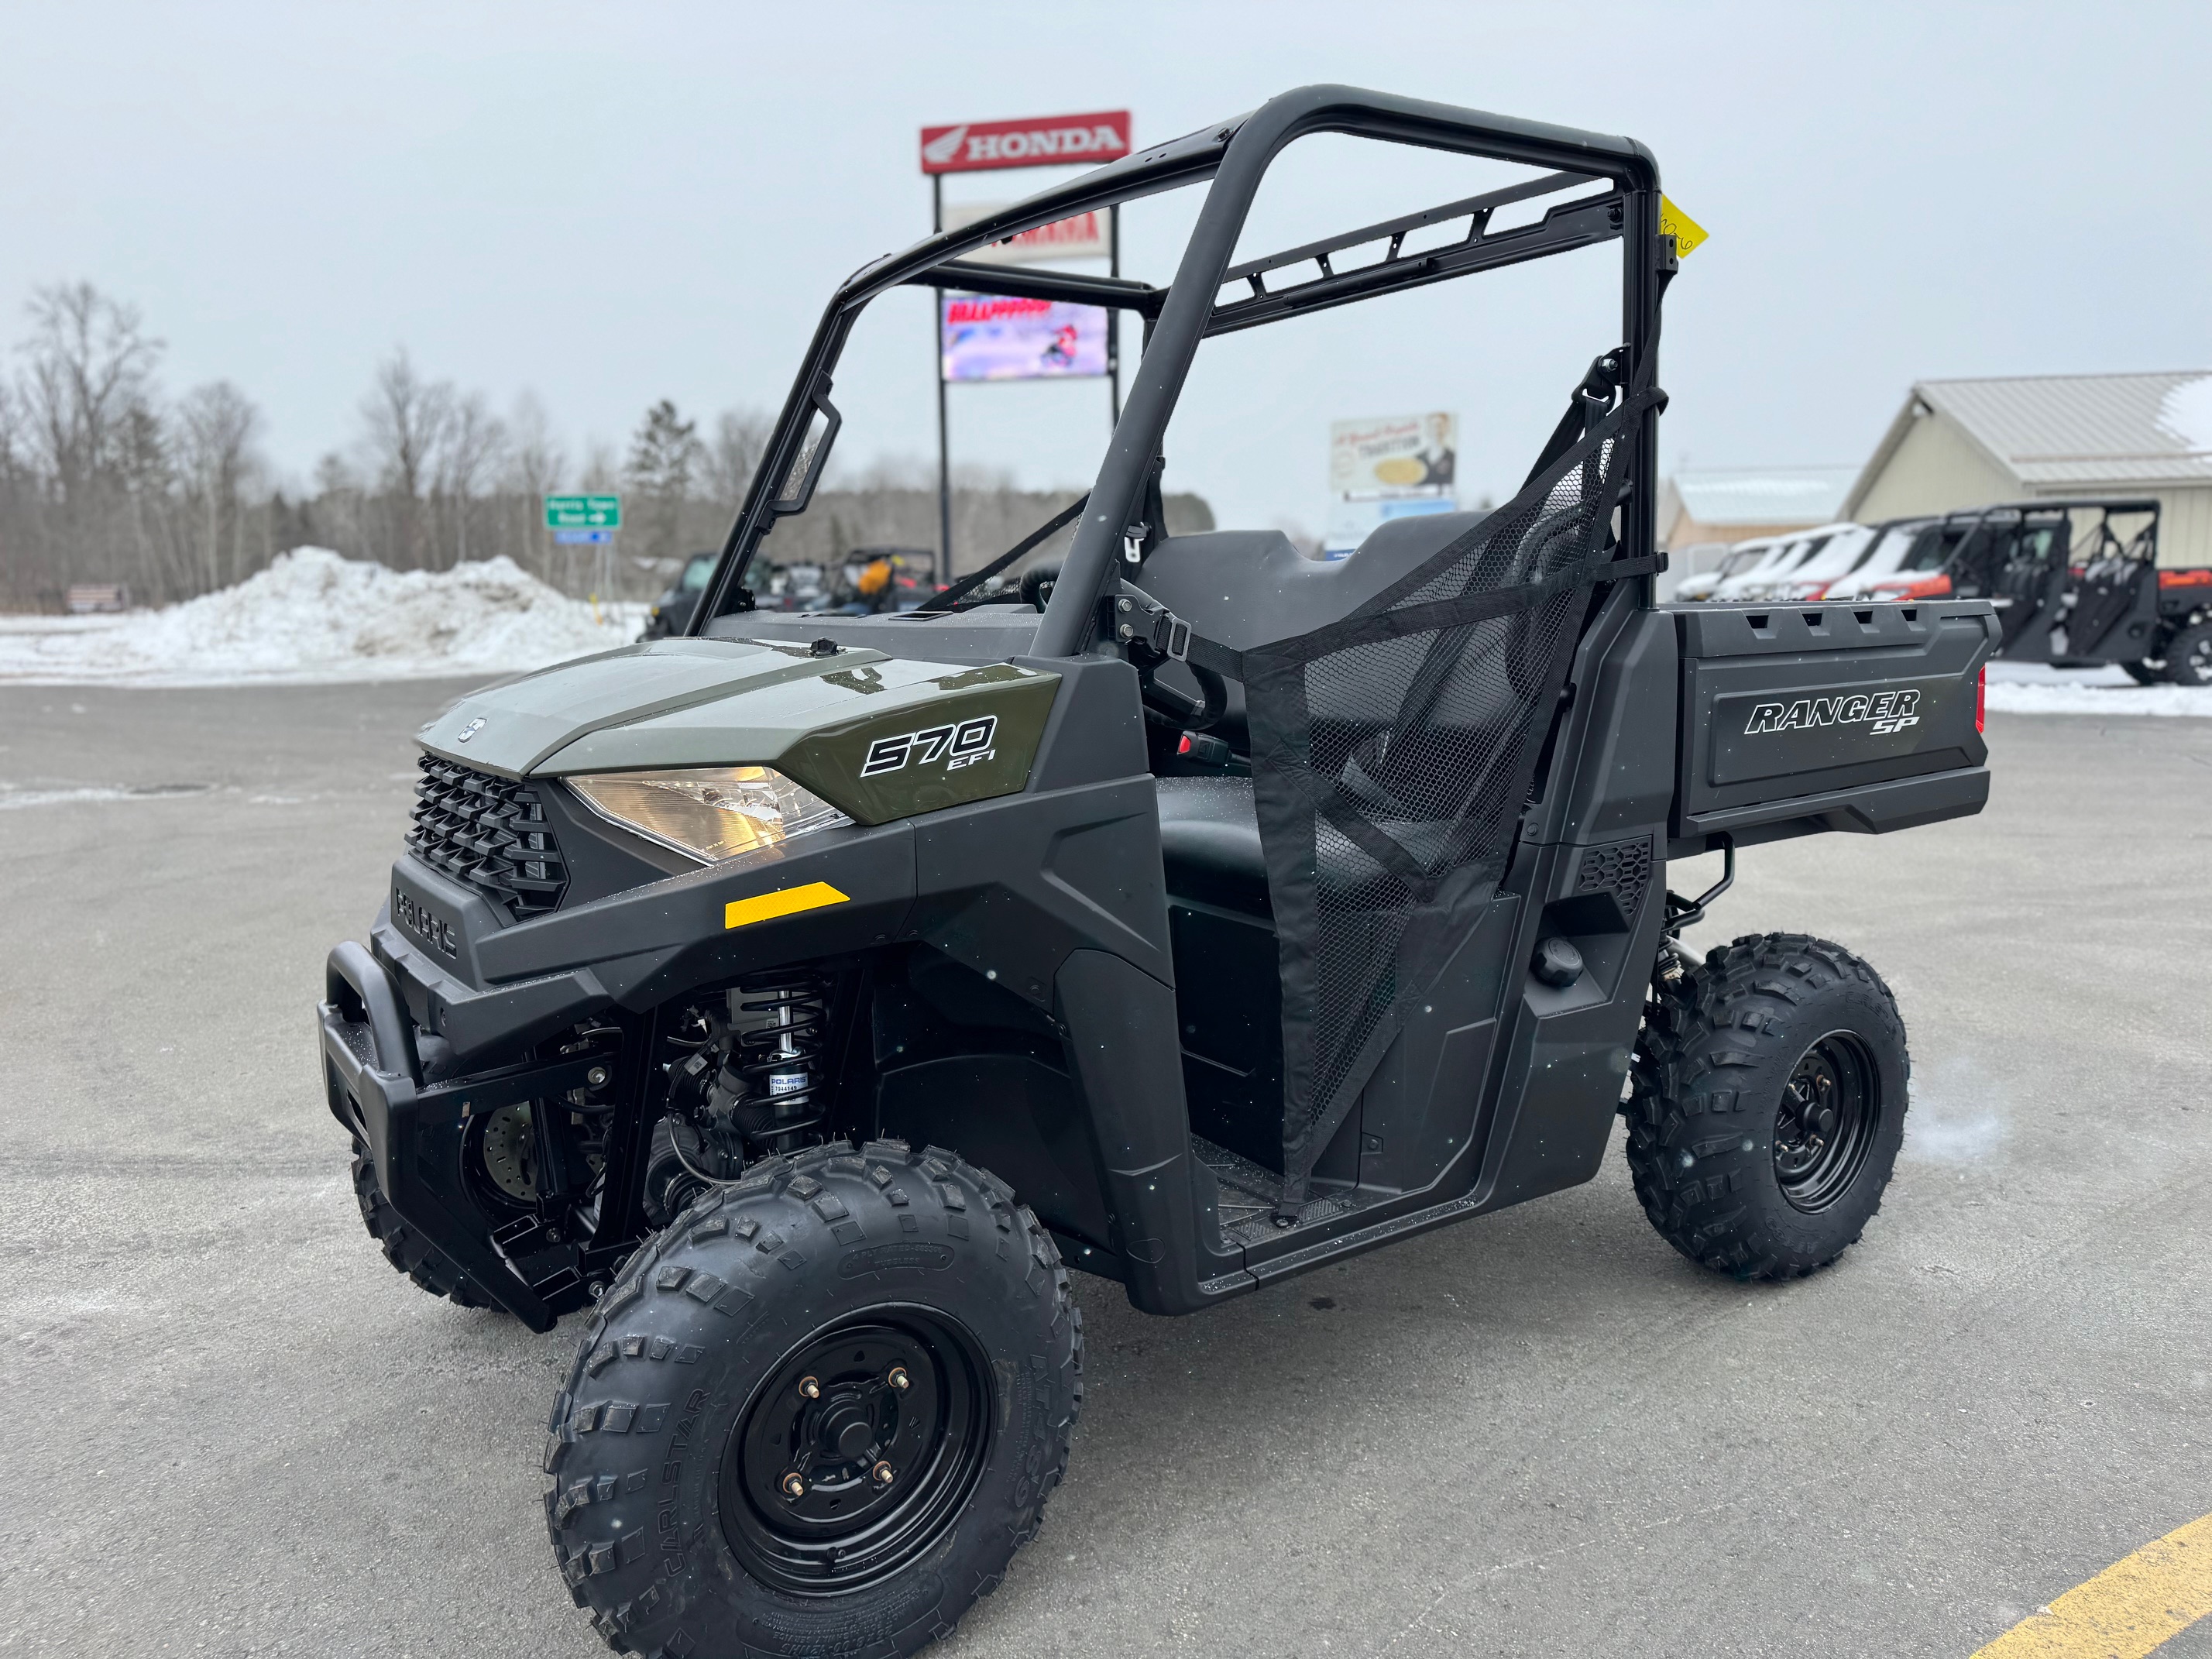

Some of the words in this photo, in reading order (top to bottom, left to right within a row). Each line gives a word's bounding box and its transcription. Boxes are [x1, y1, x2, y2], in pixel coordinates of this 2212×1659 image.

[968, 125, 1123, 160] HONDA
[1744, 689, 1921, 735] RANGER
[1869, 716, 1920, 735] SP
[860, 715, 998, 778] 570
[946, 749, 996, 771] EFI
[396, 888, 457, 960] POLARIS
[658, 1388, 711, 1578] CARLSTAR
